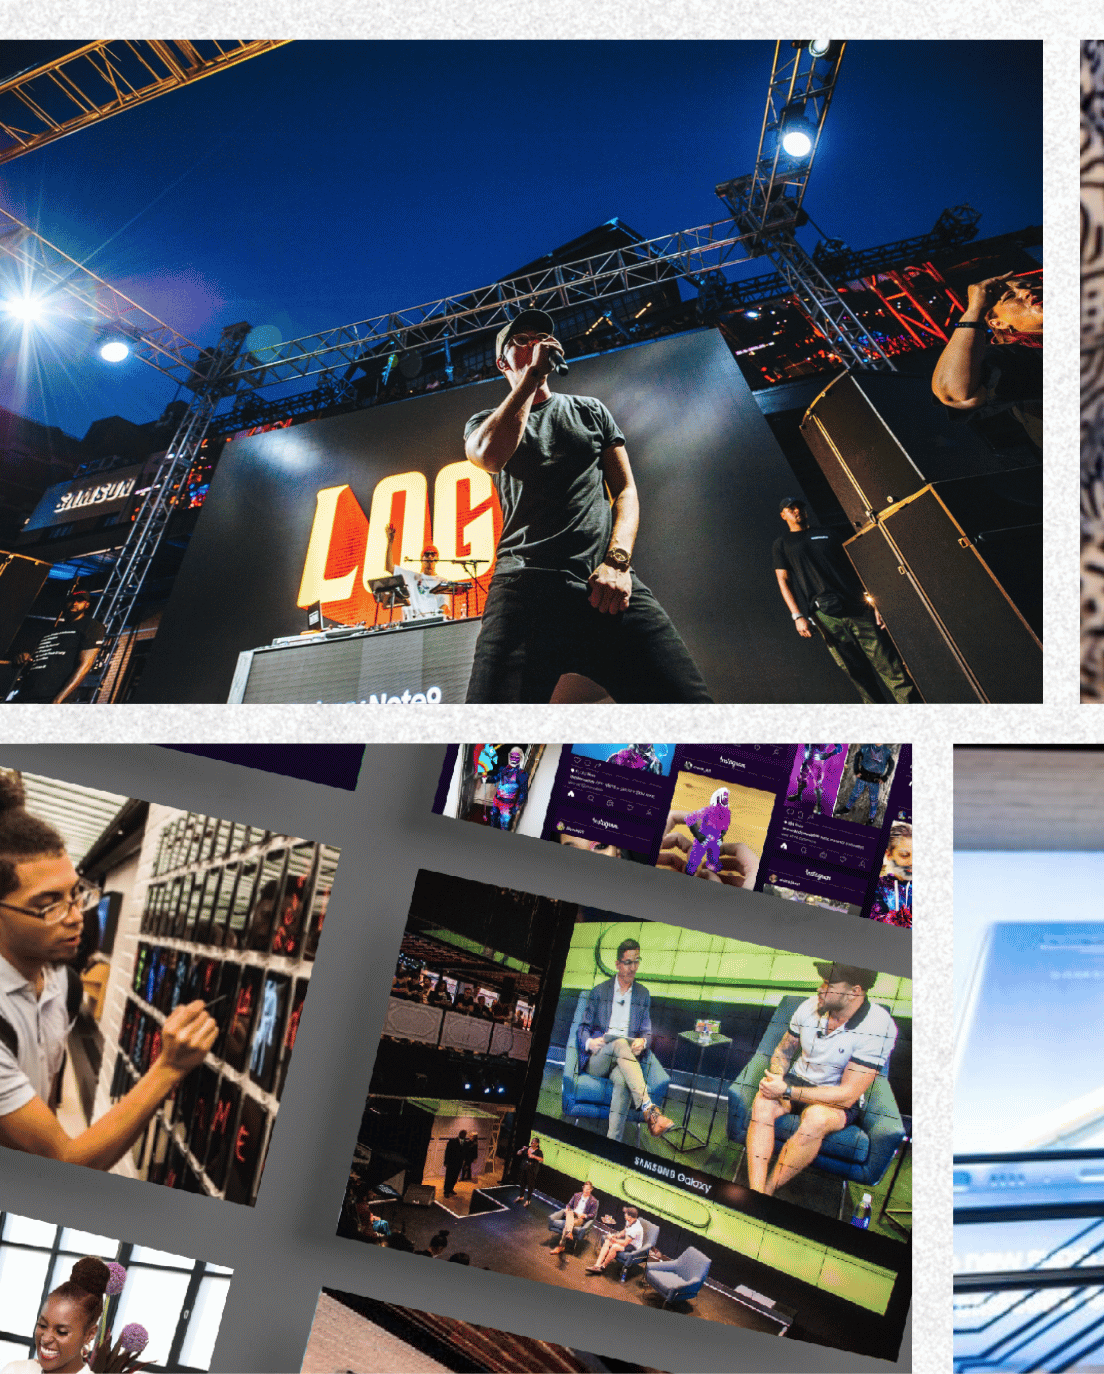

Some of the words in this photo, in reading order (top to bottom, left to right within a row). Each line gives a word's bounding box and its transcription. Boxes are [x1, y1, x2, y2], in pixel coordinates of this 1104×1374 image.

[297, 460, 496, 608] LOG
[634, 1156, 676, 1179] SAMSUNG
[677, 1173, 713, 1194] Galaxy
